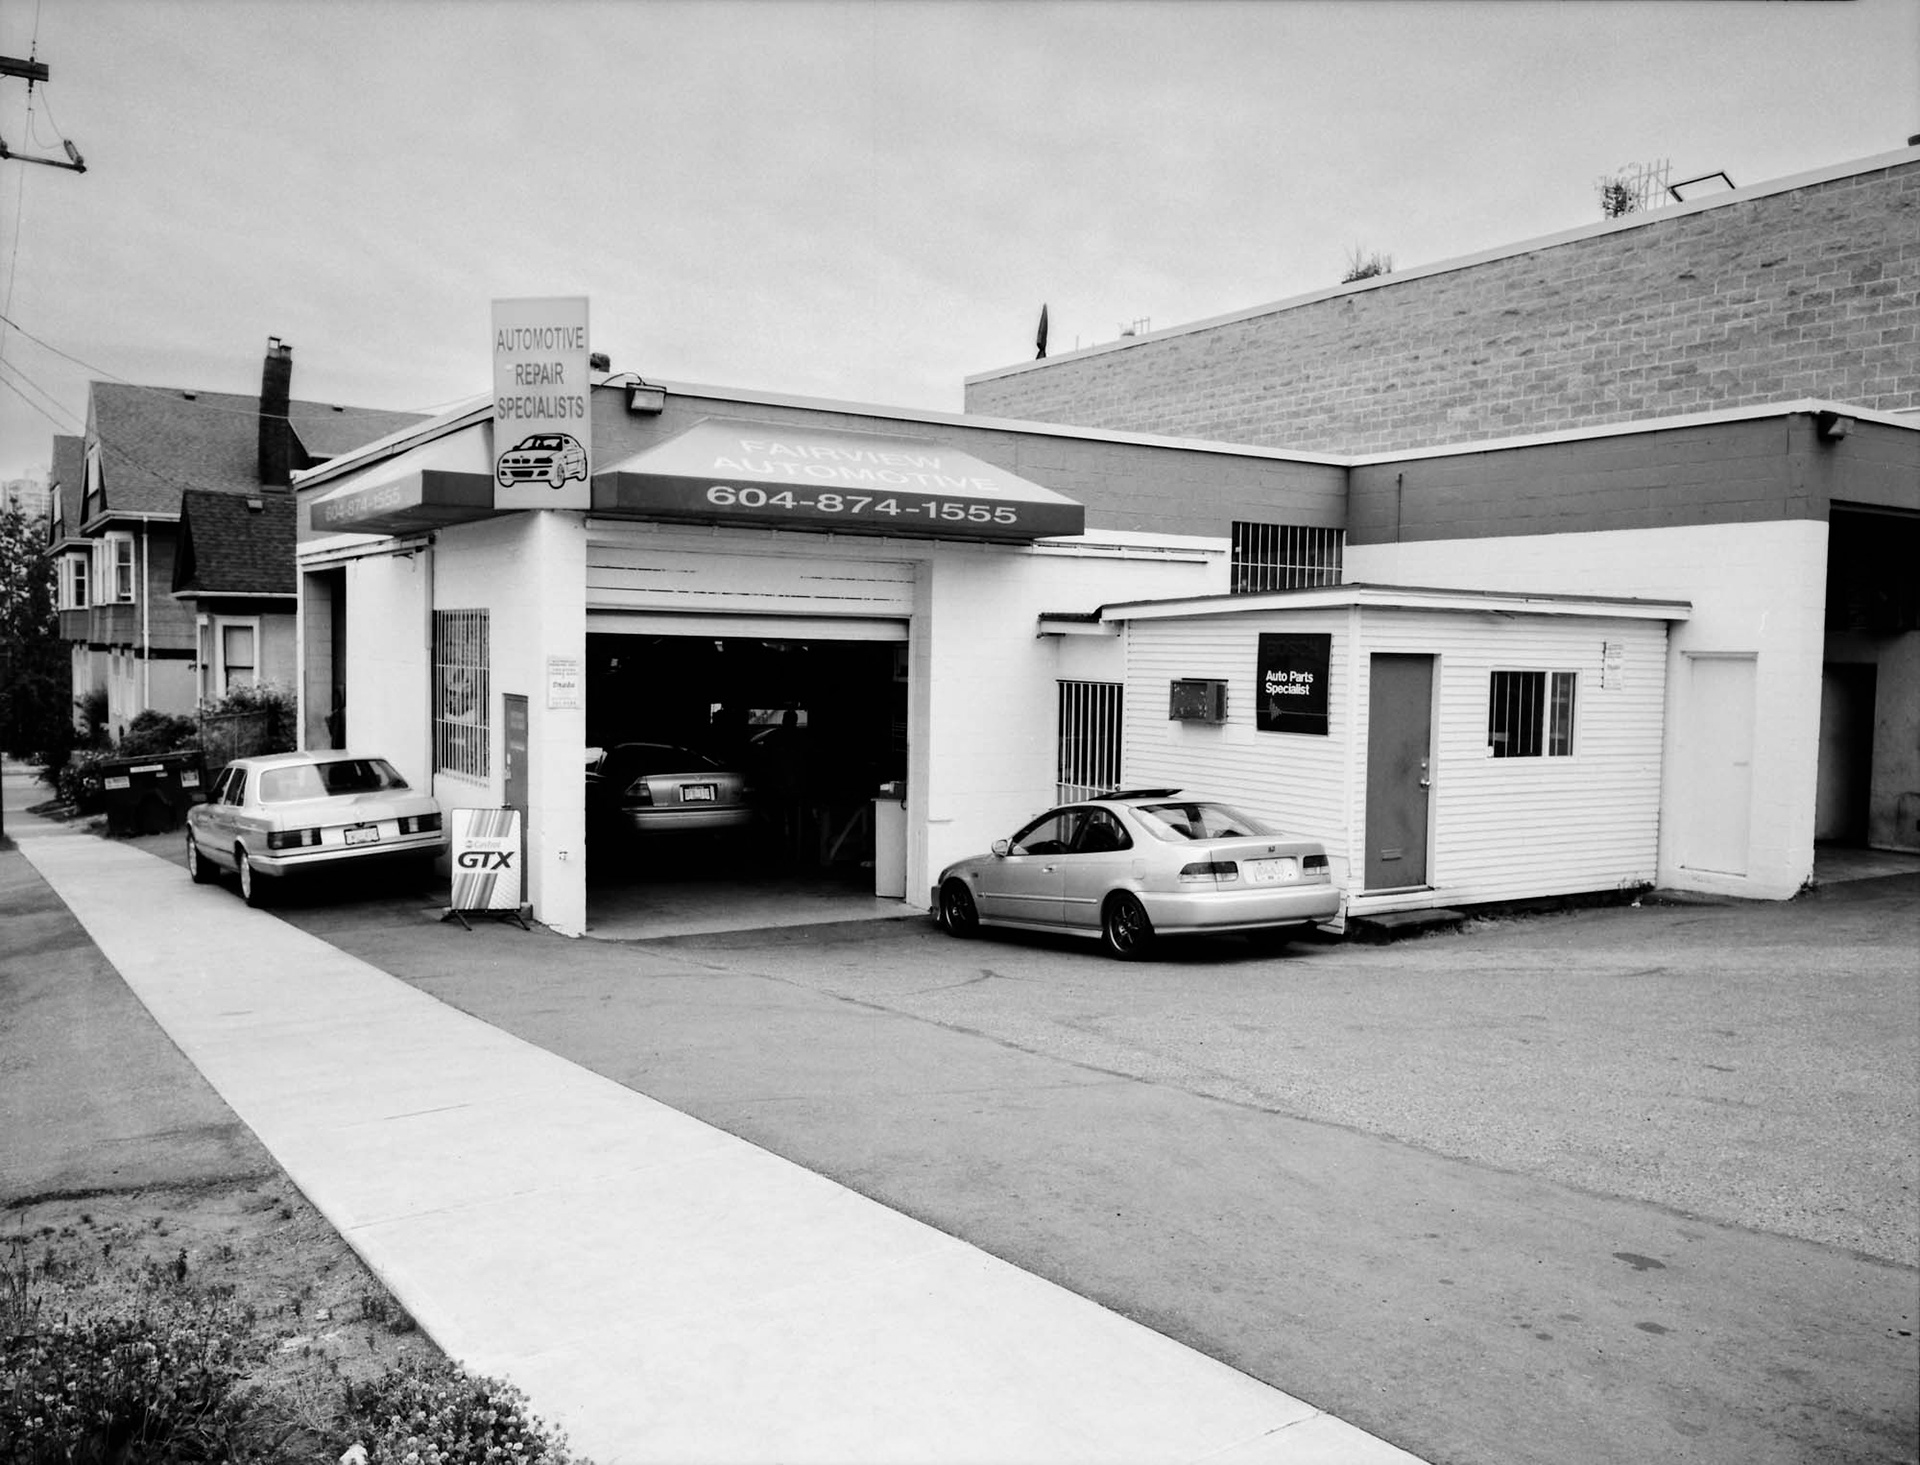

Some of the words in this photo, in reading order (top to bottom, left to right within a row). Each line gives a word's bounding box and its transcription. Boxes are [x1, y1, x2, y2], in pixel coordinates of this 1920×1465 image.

[497, 327, 584, 352] AUTOMOTIVE
[515, 362, 564, 385] REPAIR
[498, 396, 584, 419] SPECIALISTS
[739, 439, 941, 470] FAIRVIEW
[713, 456, 1000, 492] AUTOMOTIVE
[706, 485, 1018, 524] 604-874-1555
[1266, 670, 1288, 682] Auto
[1289, 671, 1314, 683] Parts
[1265, 682, 1310, 696] Specialist
[458, 851, 515, 870] GTX
